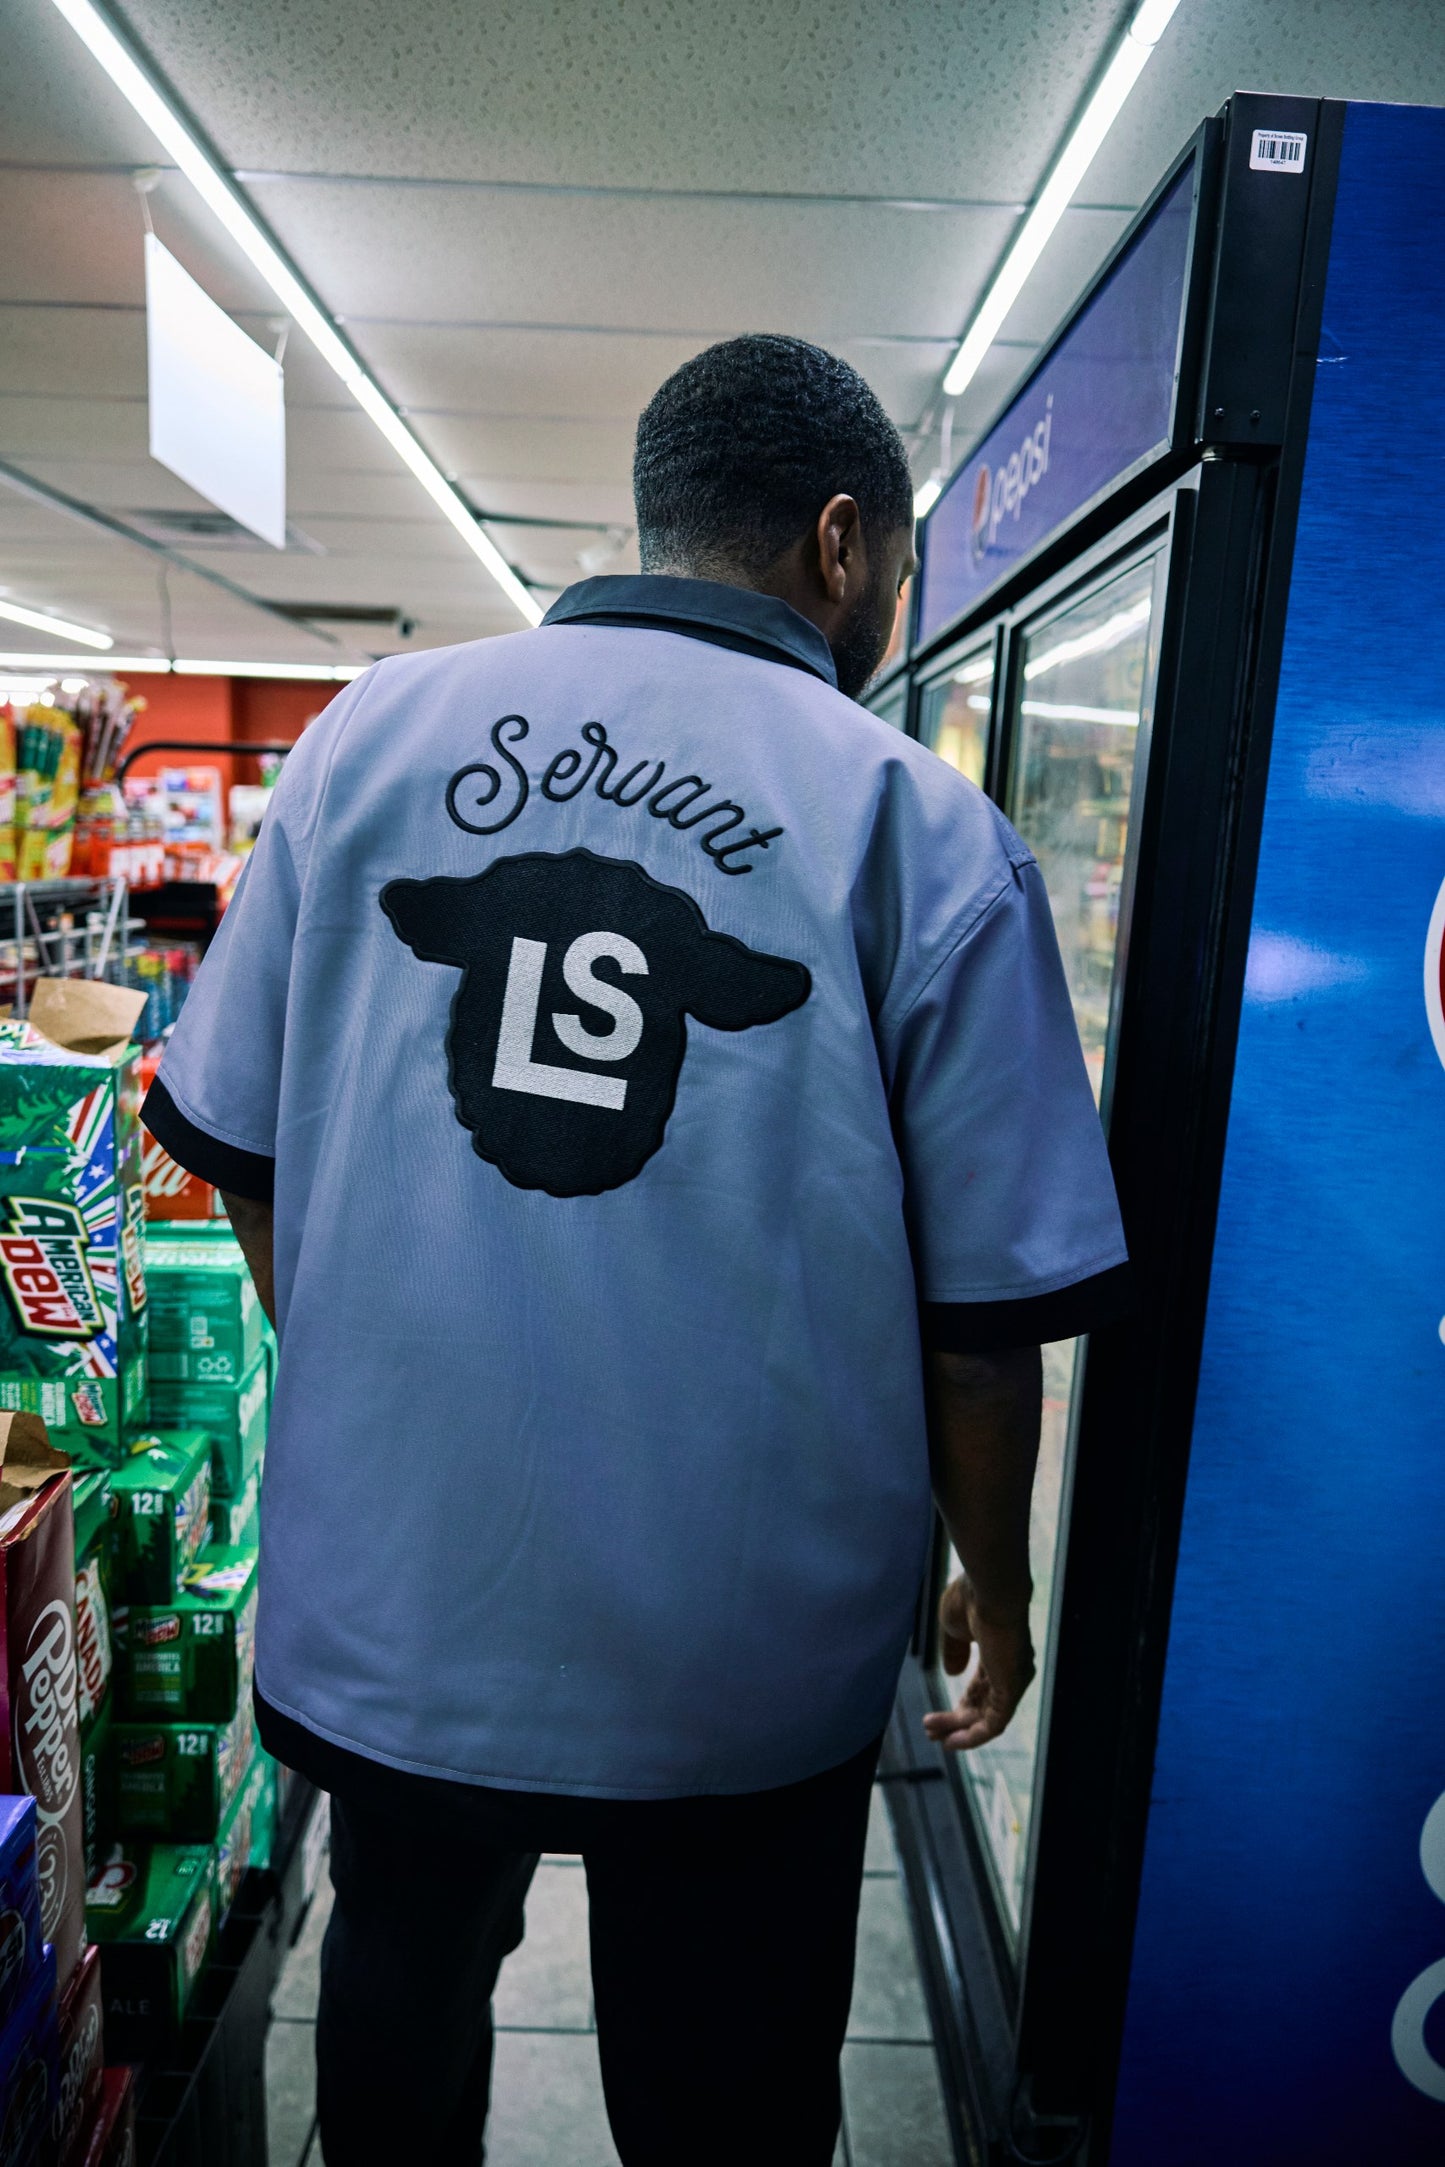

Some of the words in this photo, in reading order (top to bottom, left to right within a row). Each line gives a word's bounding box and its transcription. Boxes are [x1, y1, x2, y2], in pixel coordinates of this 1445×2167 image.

[989, 394, 1053, 544] pepsi
[446, 714, 784, 875] Servant
[492, 931, 650, 1111] LS
[131, 1491, 153, 1514] 12
[192, 1613, 214, 1635] 12
[22, 1616, 74, 1794] Pepper
[53, 1664, 78, 1729] Dr
[176, 1732, 199, 1756] 12
